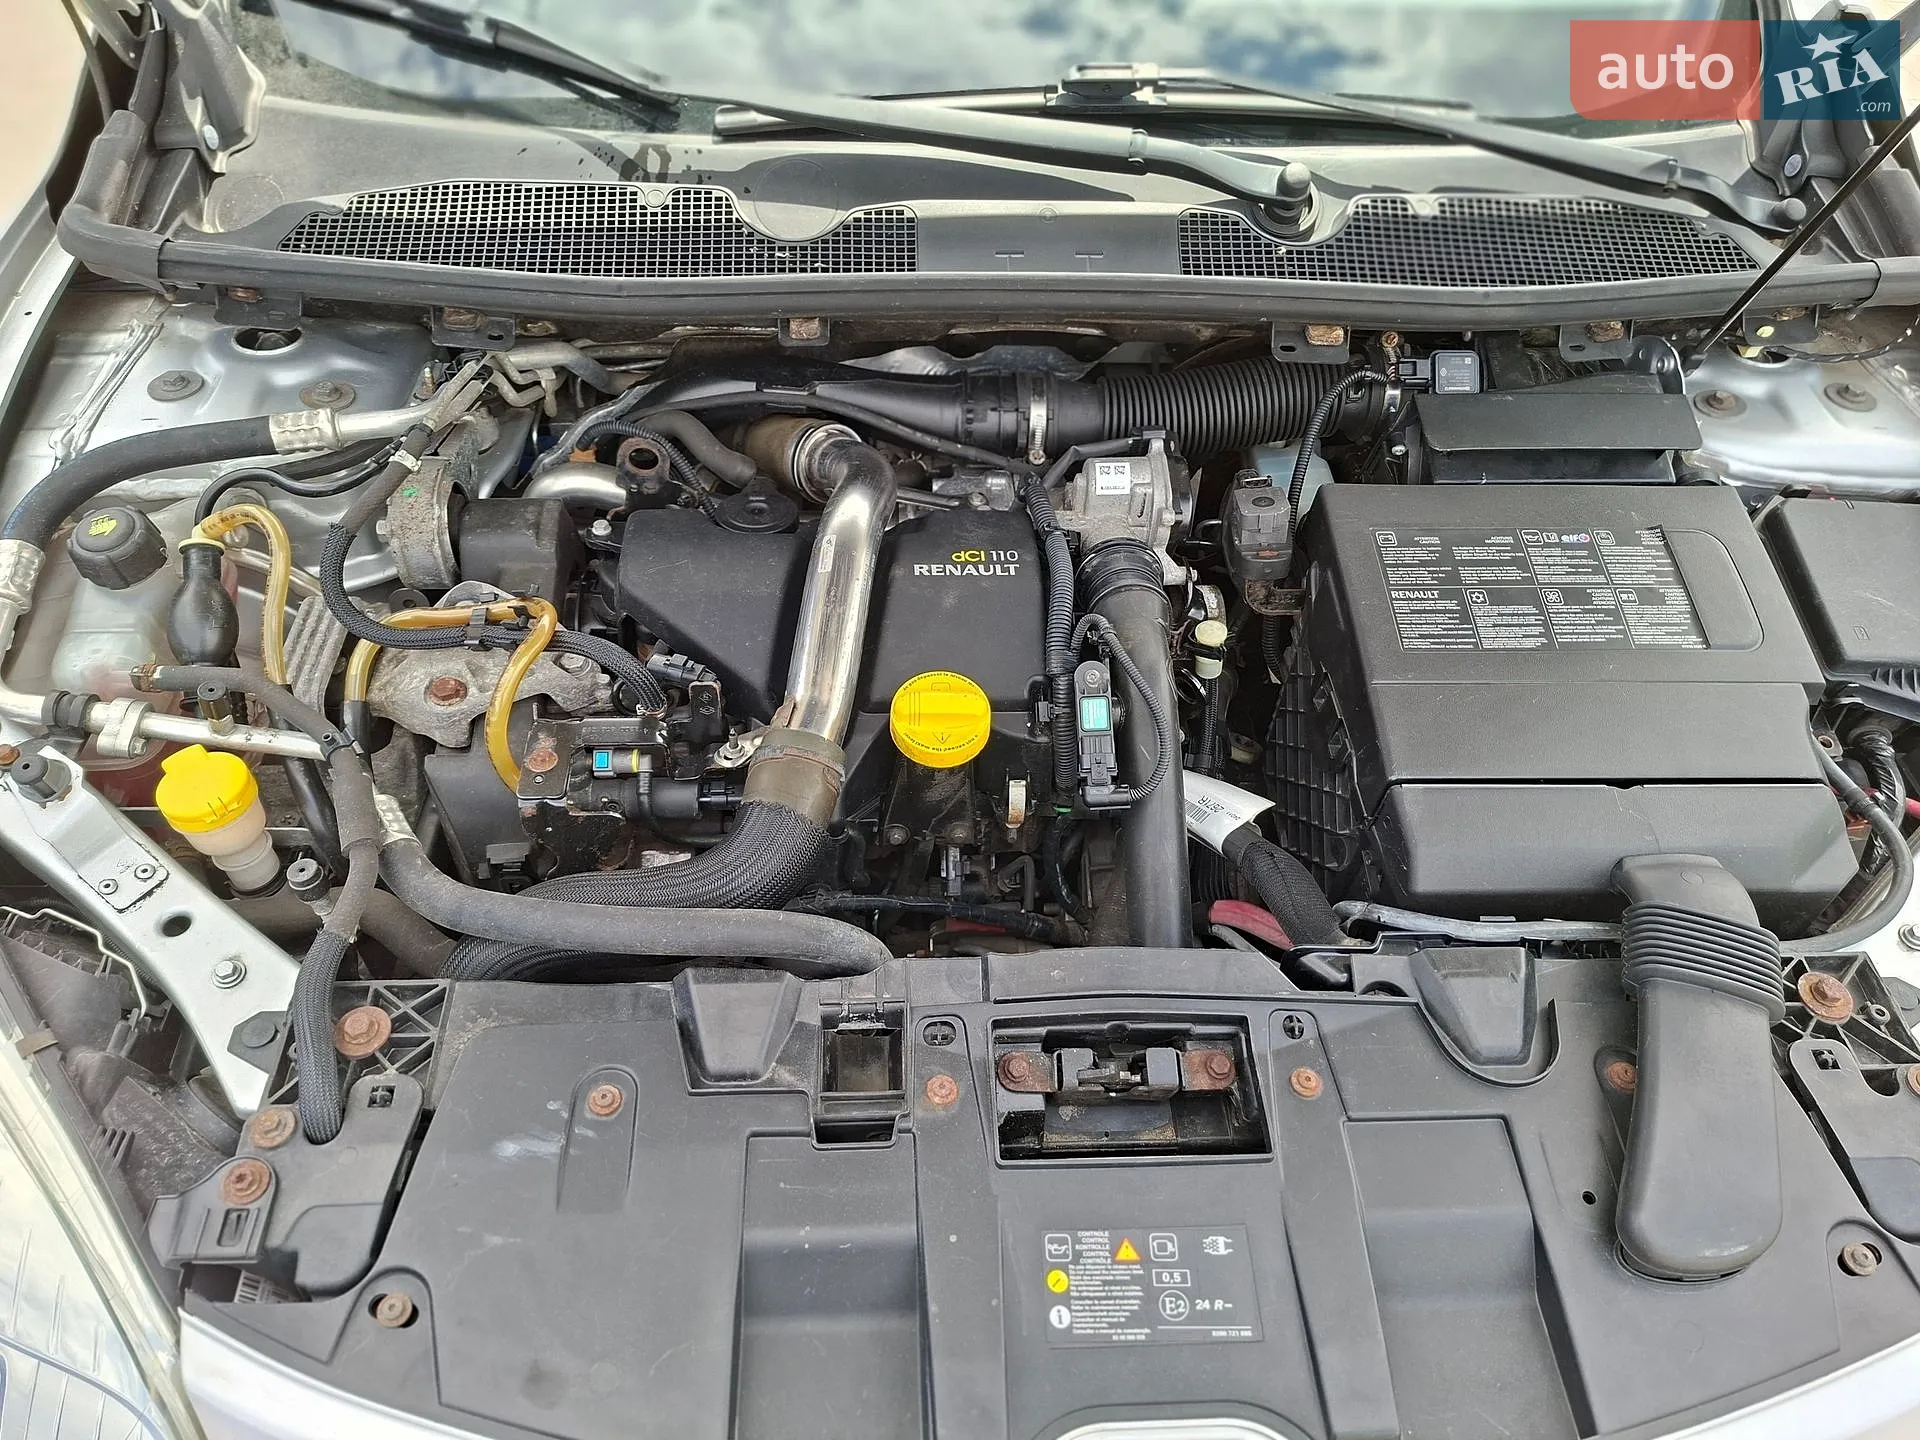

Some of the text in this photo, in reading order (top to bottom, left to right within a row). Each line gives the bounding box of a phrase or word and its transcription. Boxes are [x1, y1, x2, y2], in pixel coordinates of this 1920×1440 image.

[990, 550, 1018, 562] 110
[914, 564, 1020, 576] RENAULT
[1162, 1272, 1181, 1283] 0,5
[1164, 1297, 1186, 1314] E2
[1195, 1299, 1210, 1310] 24
